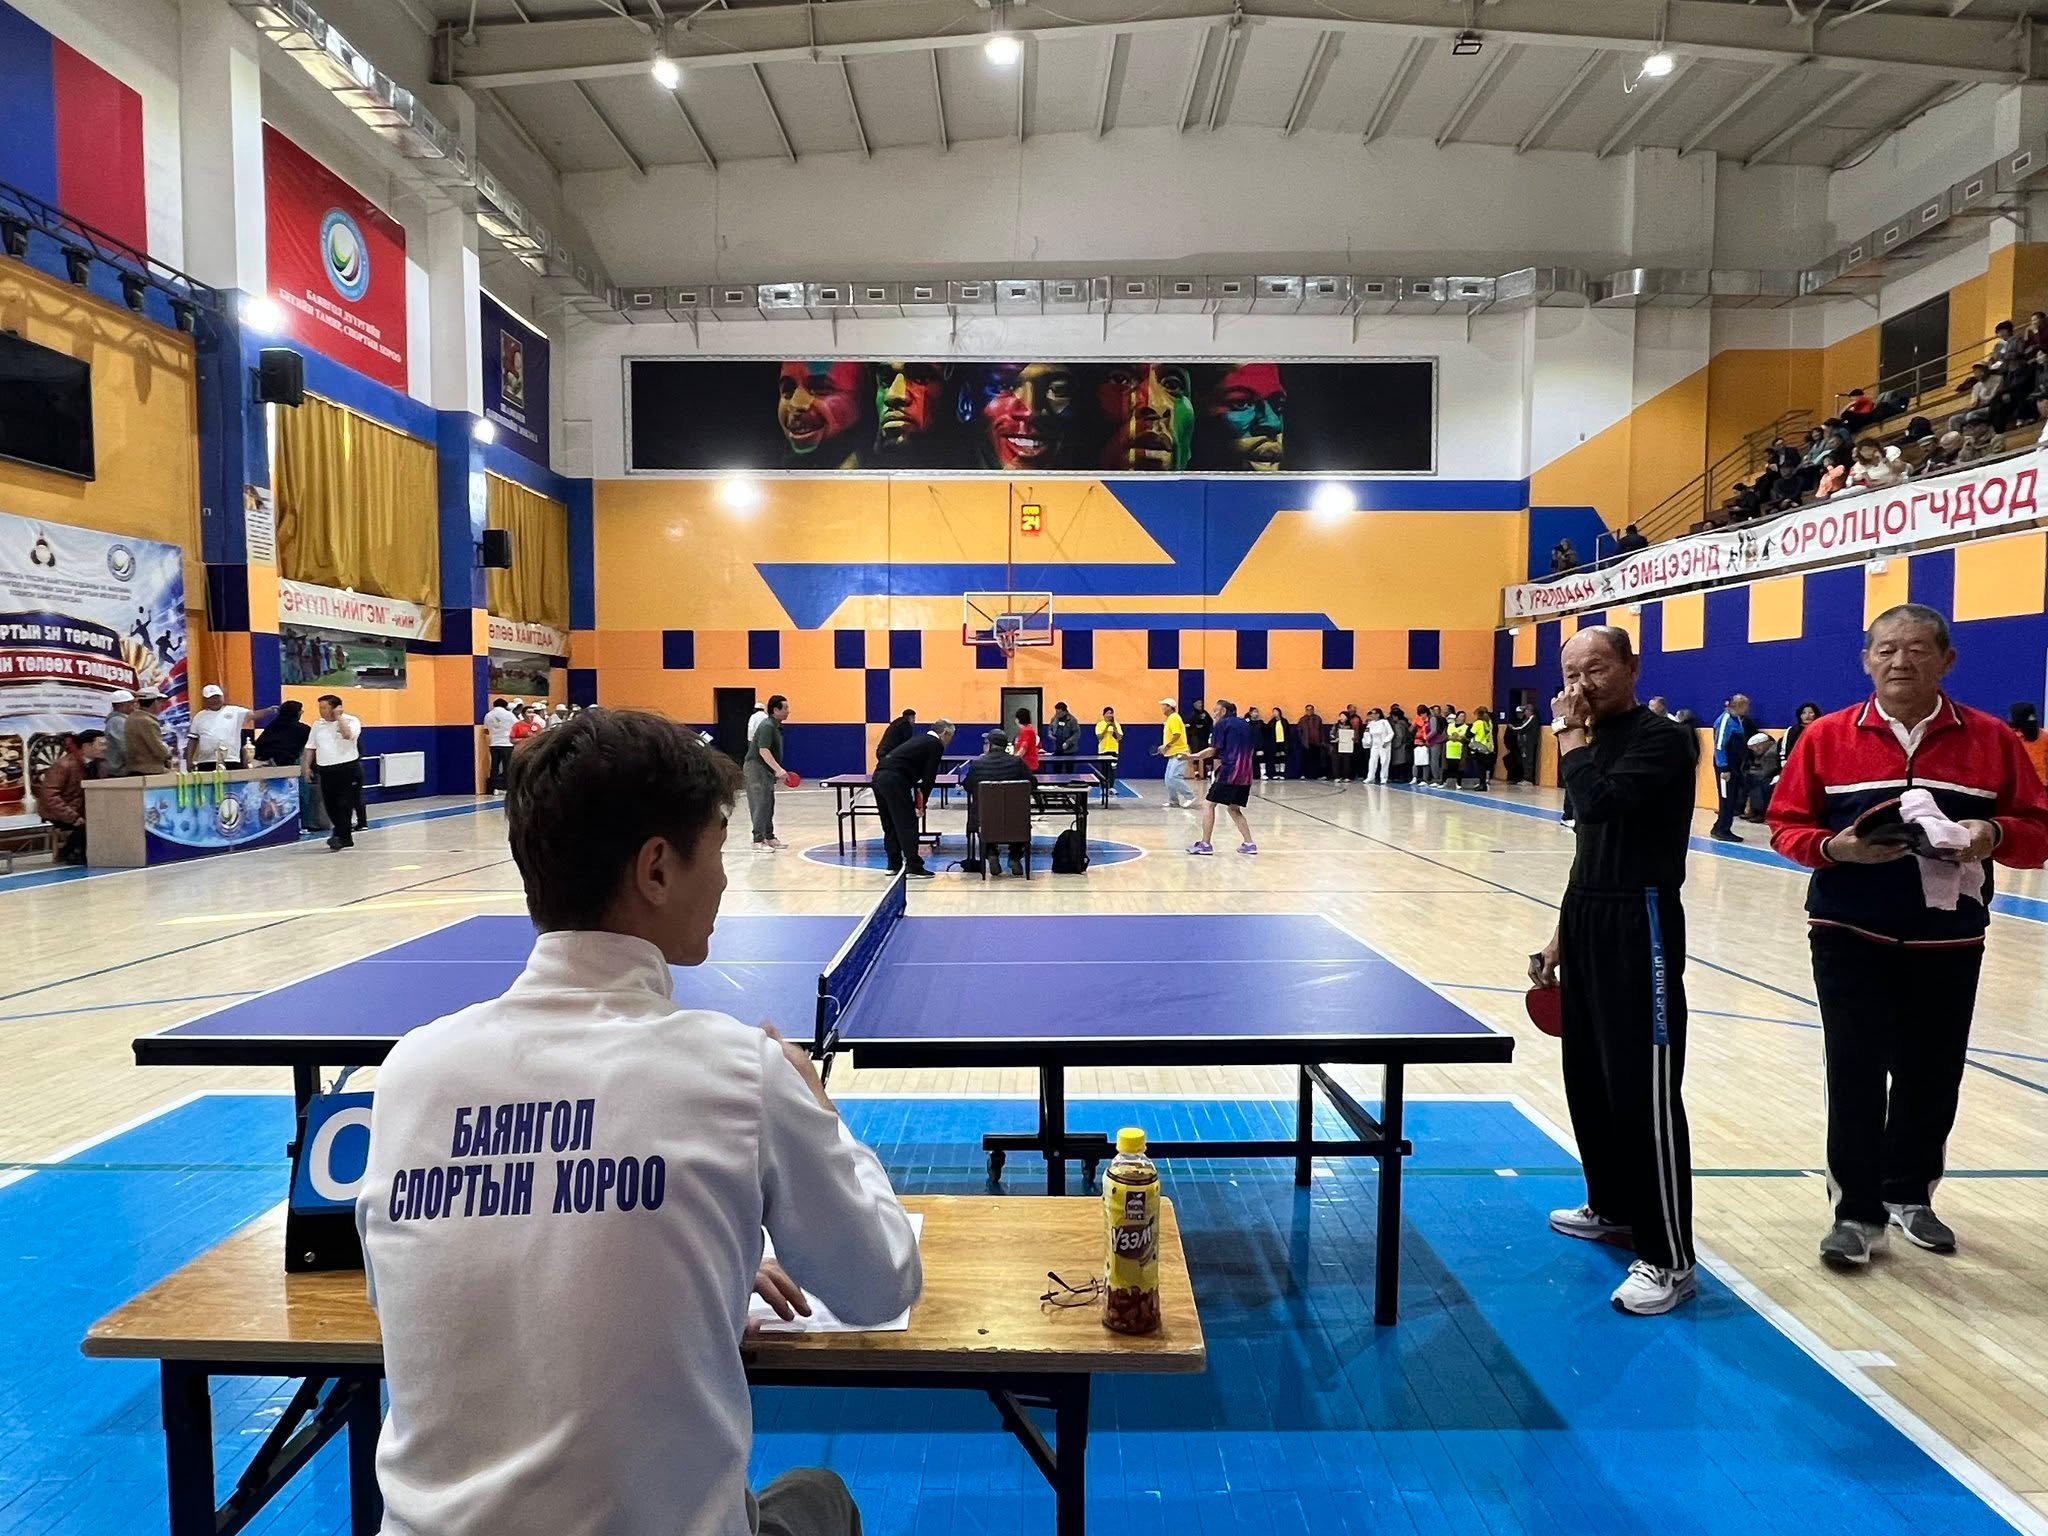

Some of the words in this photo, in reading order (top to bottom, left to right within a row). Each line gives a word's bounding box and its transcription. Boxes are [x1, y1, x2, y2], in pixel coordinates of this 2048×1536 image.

[1780, 468, 2039, 556] ОРОЛЦОГЧДОД
[1528, 579, 1595, 610] УРАЛДААН
[1620, 544, 1721, 590] ТЭМЦЭЭНД
[15, 656, 74, 674] ТӨЛӨӨХ
[450, 1098, 596, 1159] БАЯНГОЛ
[388, 1161, 535, 1223] СПОРТЫН
[552, 1154, 666, 1215] ХОРОО
[1112, 1225, 1152, 1253] УЗЭМ
